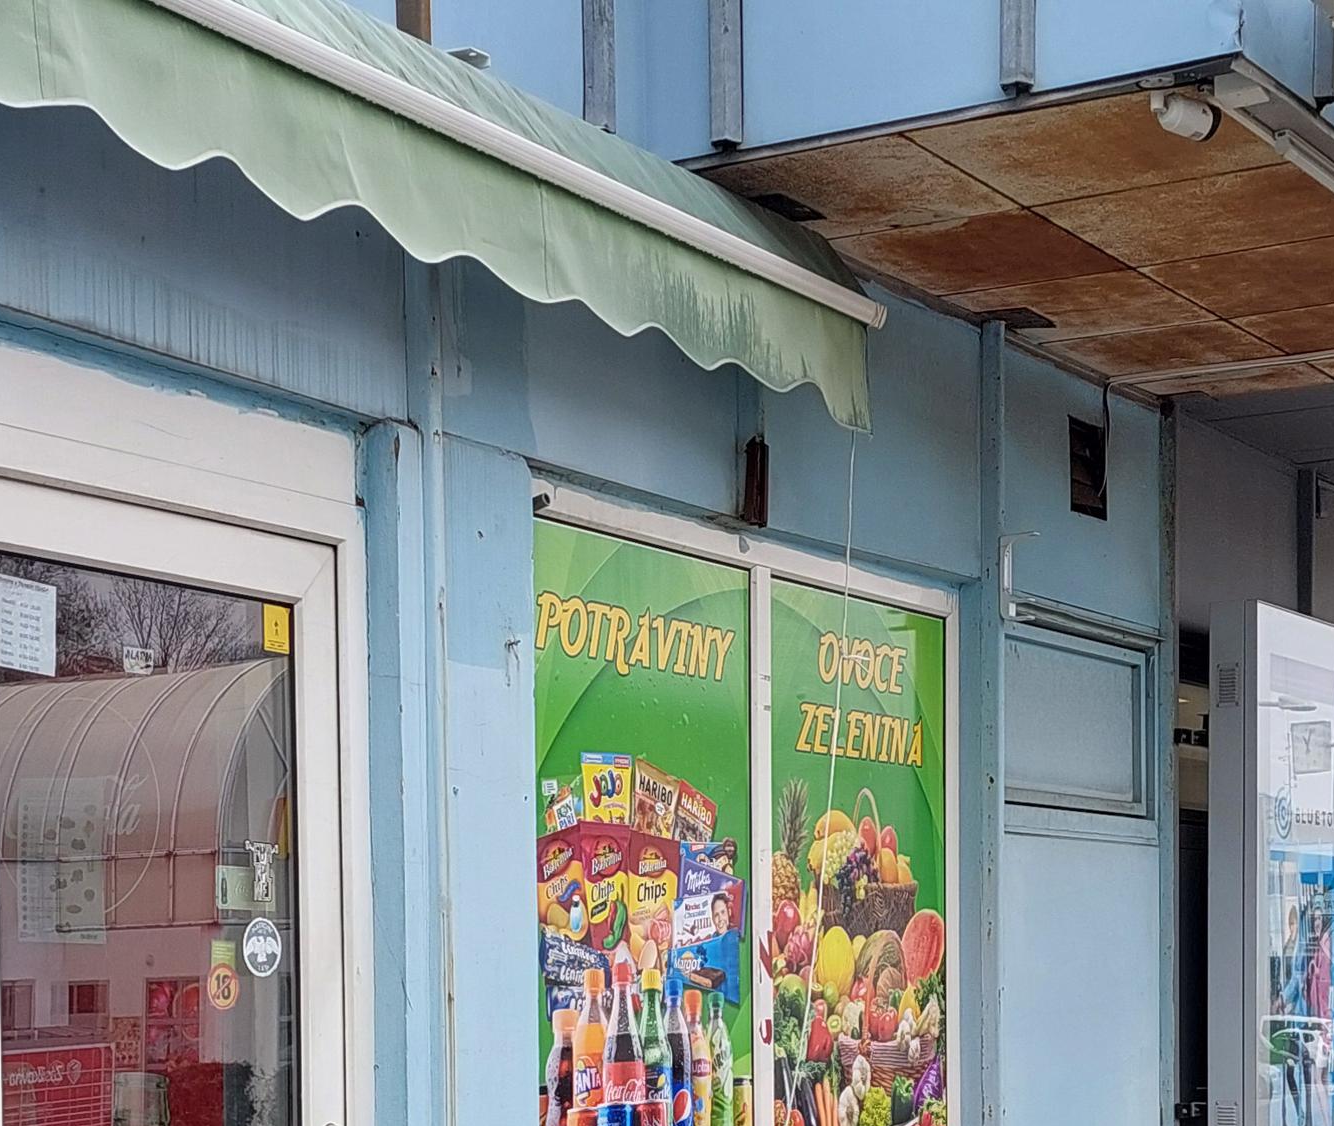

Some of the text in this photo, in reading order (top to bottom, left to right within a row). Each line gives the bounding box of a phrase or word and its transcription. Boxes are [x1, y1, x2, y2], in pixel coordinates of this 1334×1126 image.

[535, 592, 735, 681] POTRAVINY
[818, 632, 908, 695] OVOCE
[796, 701, 924, 768] ZELENINA
[638, 774, 673, 807] HARIBO
[681, 792, 713, 826] HARIBO
[545, 873, 569, 900] Chips
[591, 880, 615, 903] Chips
[637, 882, 667, 904] Chips
[684, 869, 712, 891] Milka
[673, 955, 702, 974] Margot
